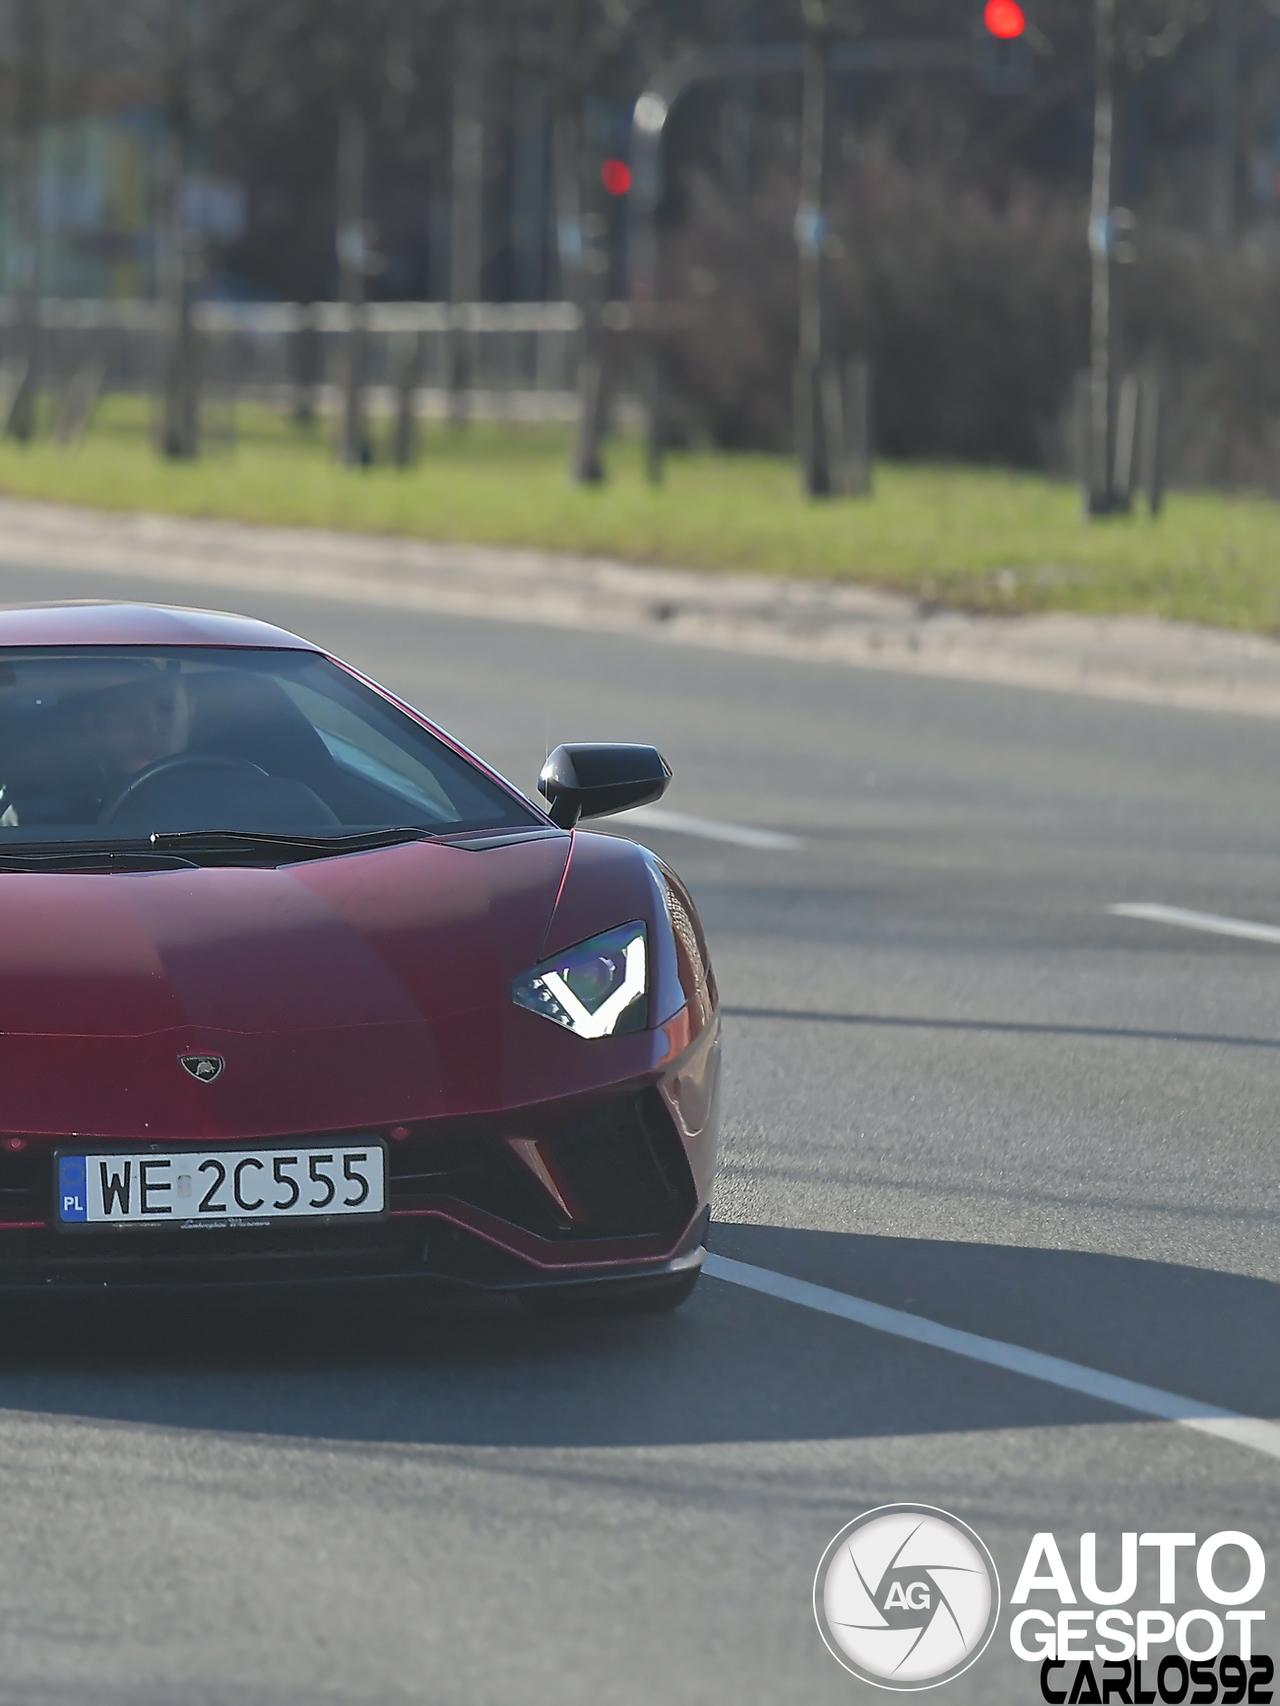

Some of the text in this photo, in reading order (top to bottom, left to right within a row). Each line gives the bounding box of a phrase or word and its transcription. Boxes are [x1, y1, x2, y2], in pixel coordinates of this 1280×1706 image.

[99, 1153, 370, 1215] WE 2C555
[63, 1197, 84, 1212] PL
